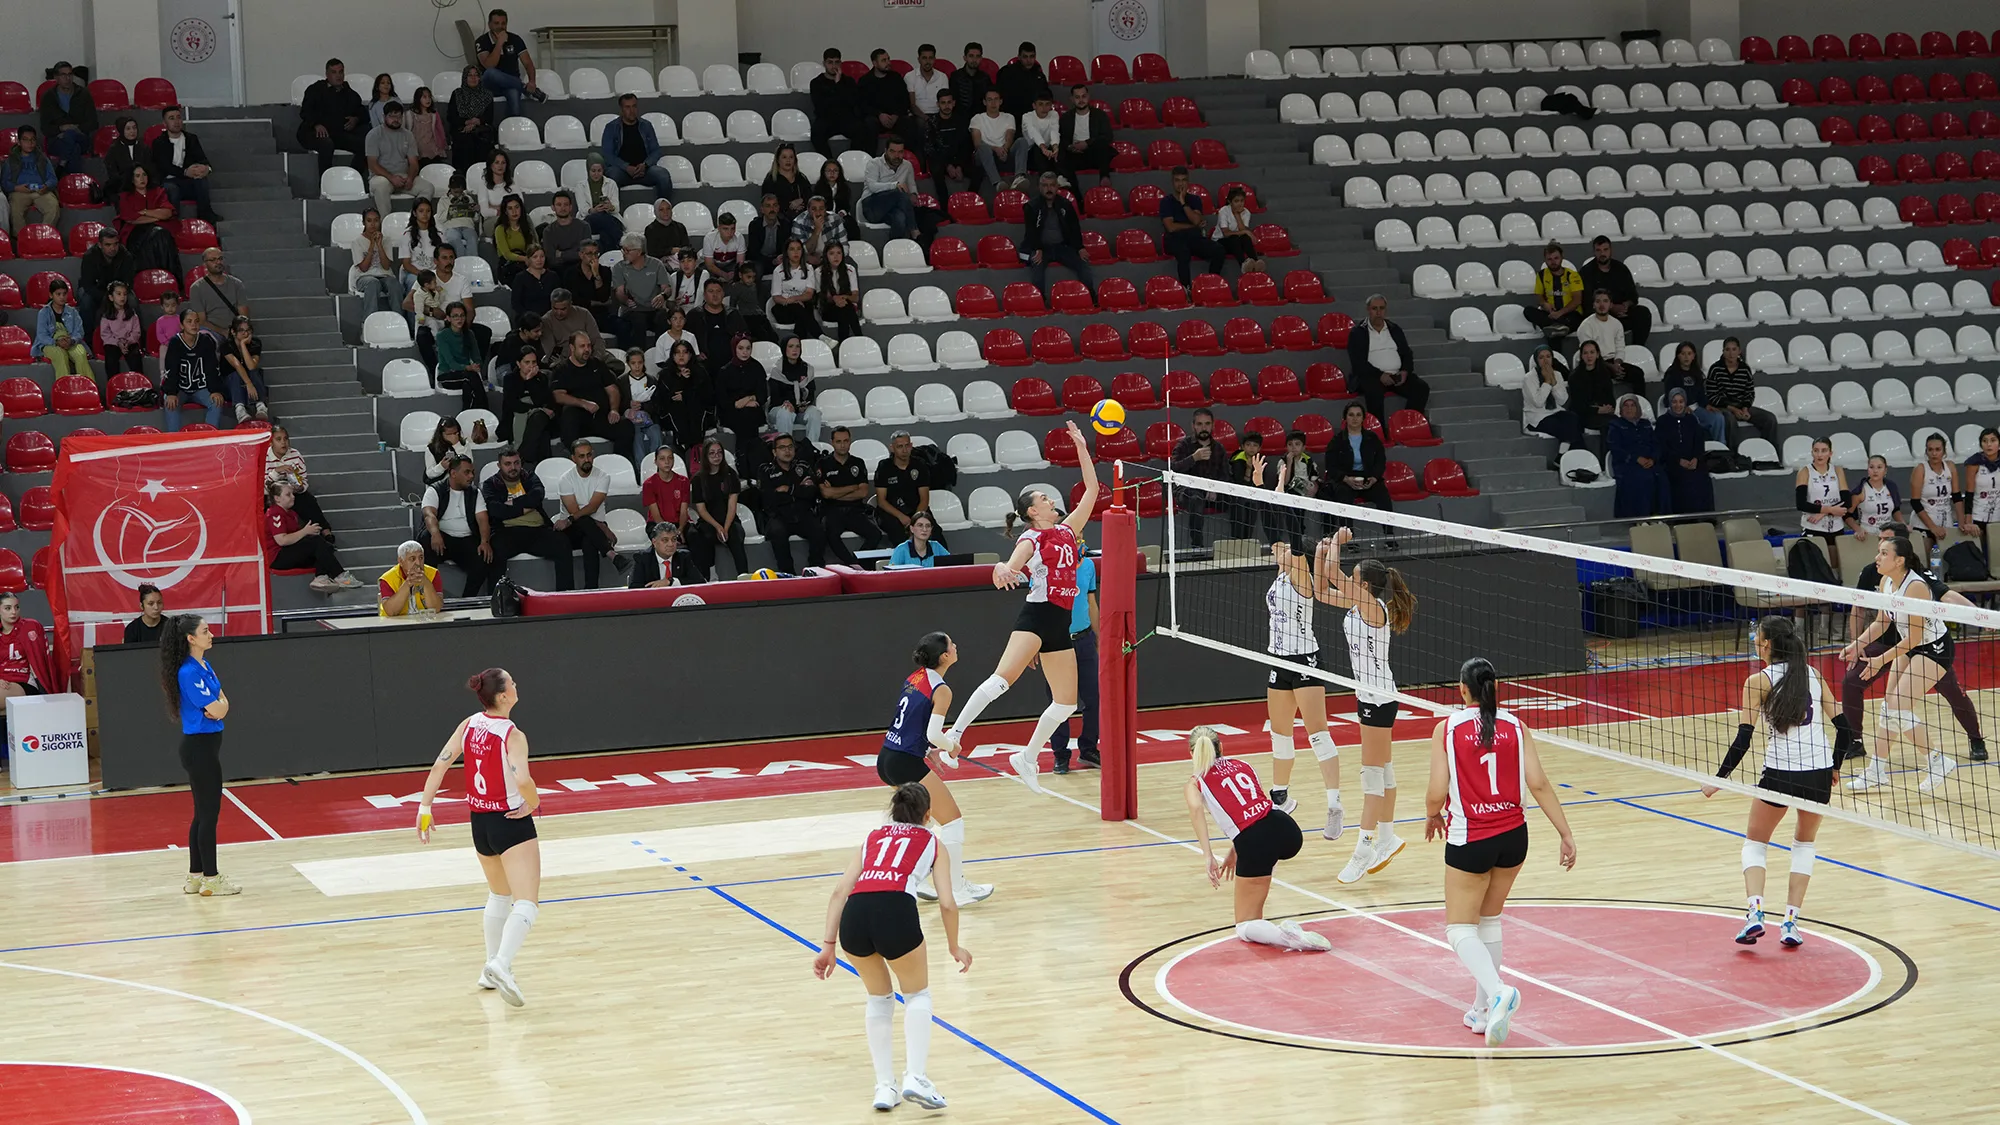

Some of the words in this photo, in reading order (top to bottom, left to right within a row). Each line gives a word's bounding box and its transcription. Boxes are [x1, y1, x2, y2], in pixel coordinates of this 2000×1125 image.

[178, 356, 207, 389] 94
[1822, 484, 1830, 497] 7
[1936, 485, 1948, 497] 14
[1876, 502, 1889, 515] 15
[1053, 543, 1075, 569] 28
[893, 695, 909, 730] 3
[474, 758, 487, 795] 6
[1221, 772, 1258, 806] 19
[1480, 752, 1500, 796] 1
[1243, 800, 1270, 820] AZRA
[873, 836, 912, 869] 11
